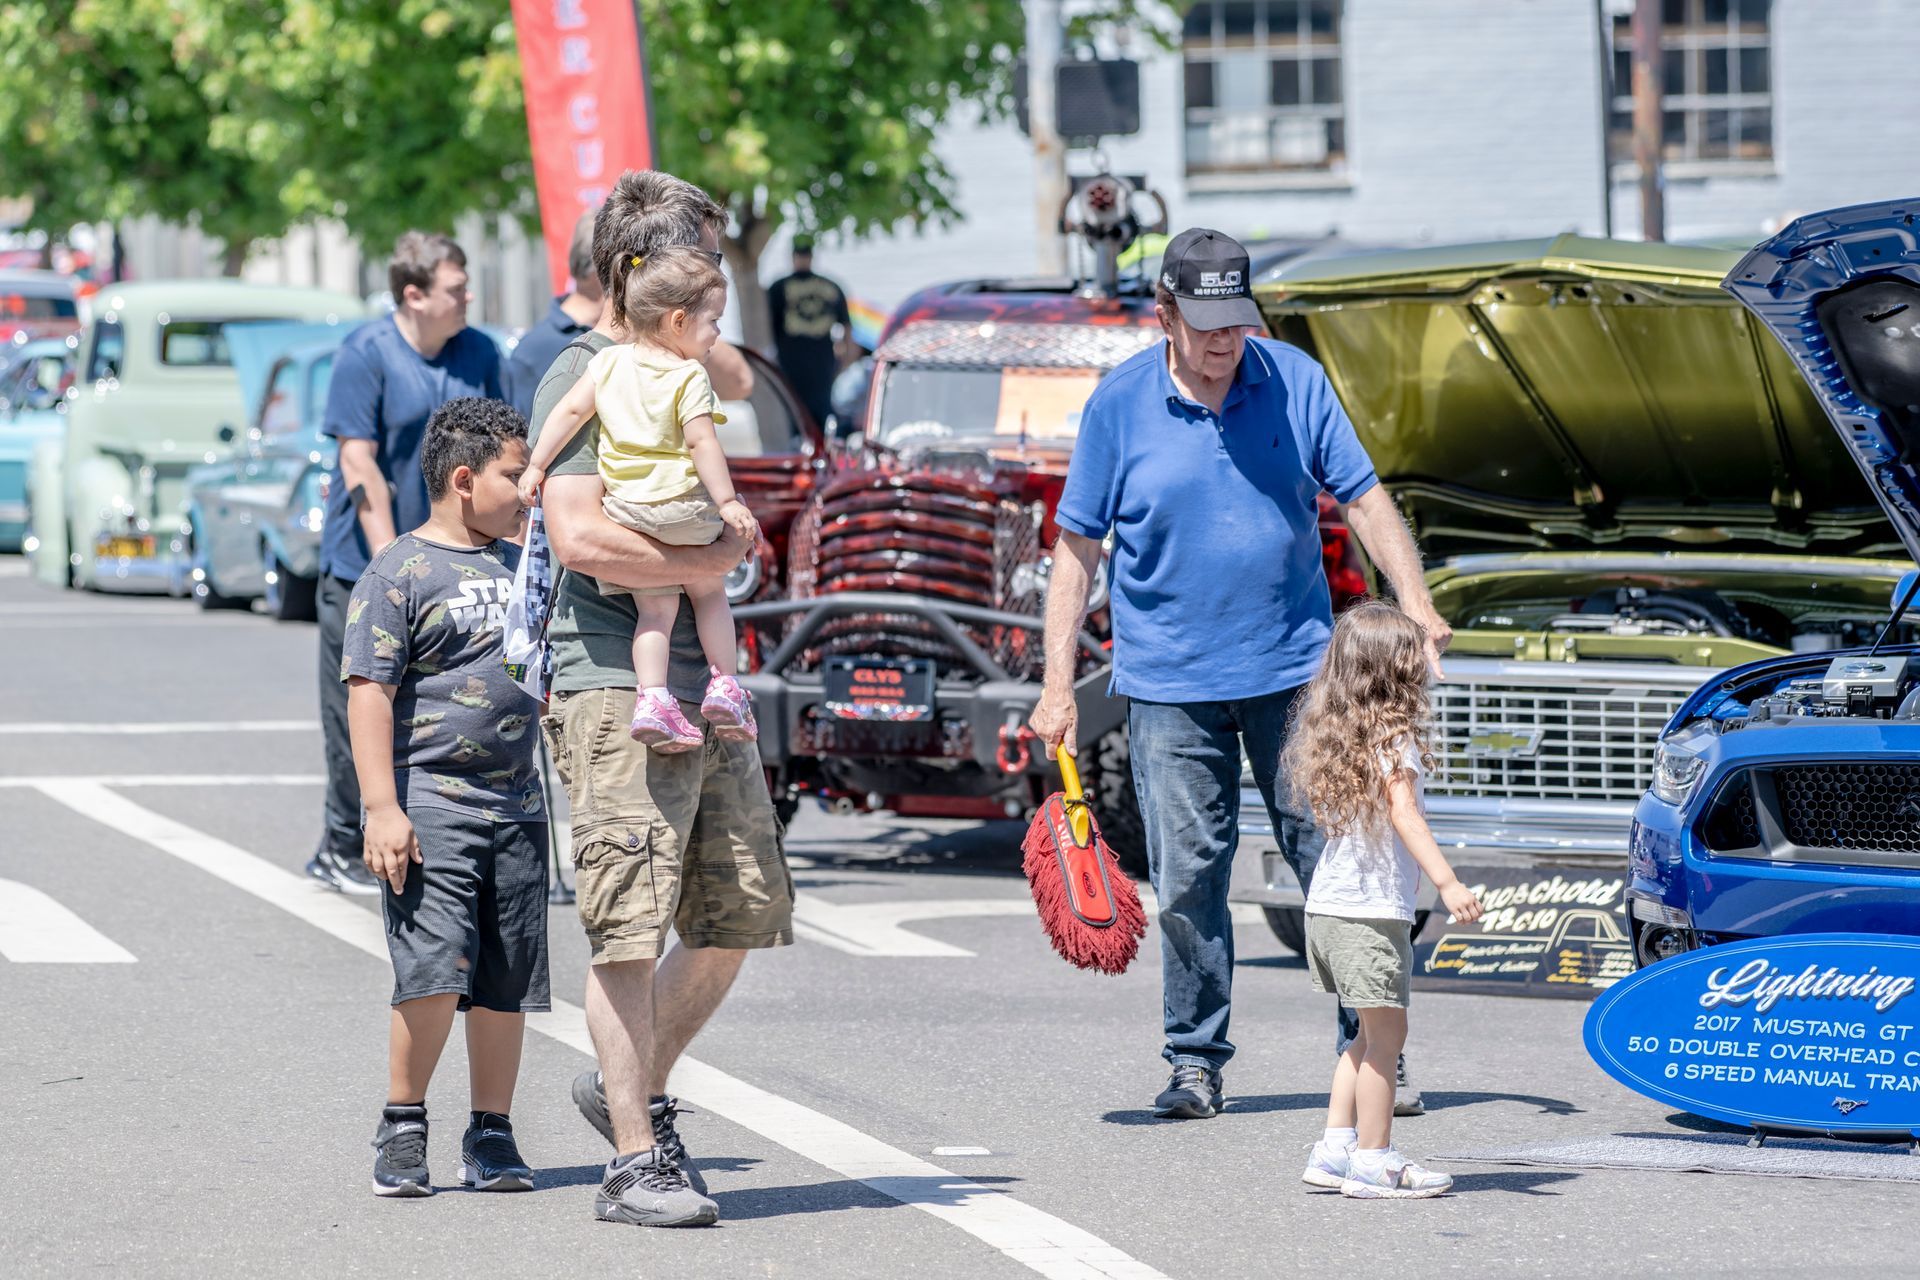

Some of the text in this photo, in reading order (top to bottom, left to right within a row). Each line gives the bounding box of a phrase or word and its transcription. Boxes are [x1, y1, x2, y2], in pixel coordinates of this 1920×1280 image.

[1200, 270, 1242, 287] 5.0
[1699, 958, 1916, 1013] Lightning
[1693, 1014, 1914, 1041] 2017 MUSTANG GT
[1627, 1036, 1660, 1053] 5.0
[1668, 1038, 1761, 1059] DOUBLE
[1769, 1044, 1896, 1065] OVERHEAD
[1663, 1062, 1679, 1079] 6
[1683, 1063, 1756, 1083] SPEED
[1763, 1067, 1856, 1088] MANUAL
